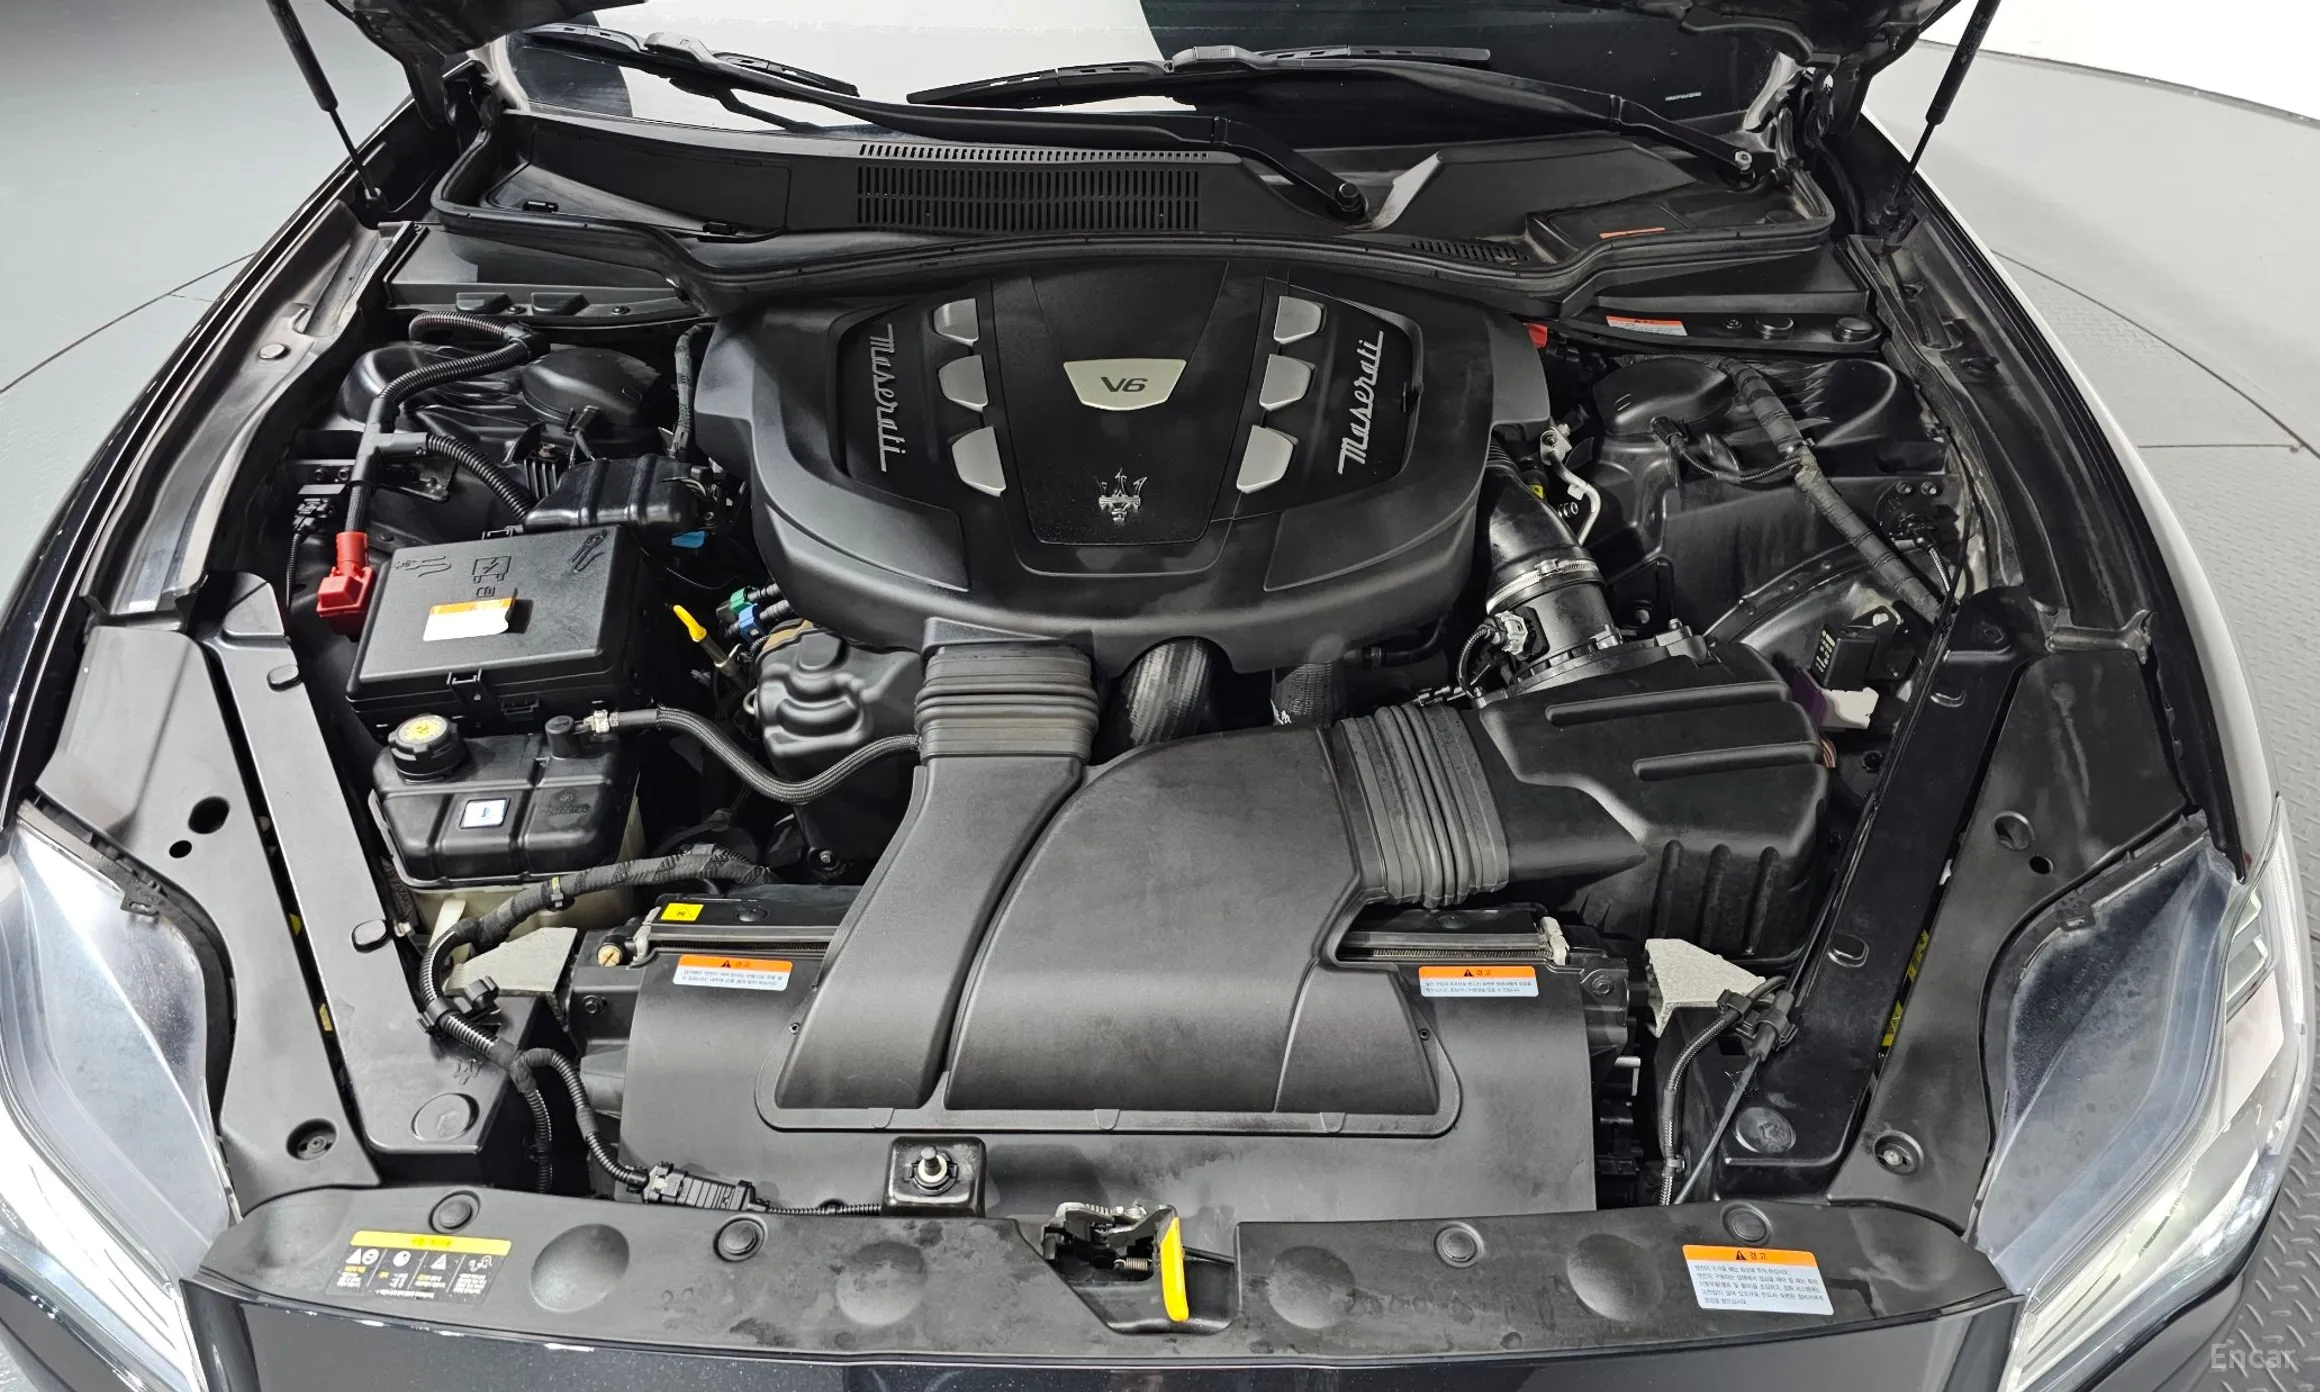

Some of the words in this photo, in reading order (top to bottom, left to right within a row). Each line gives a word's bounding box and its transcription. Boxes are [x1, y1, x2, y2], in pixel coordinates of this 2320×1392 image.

[869, 323, 906, 473] Maserati
[1100, 376, 1149, 393] V6
[1337, 330, 1384, 475] Maserati
